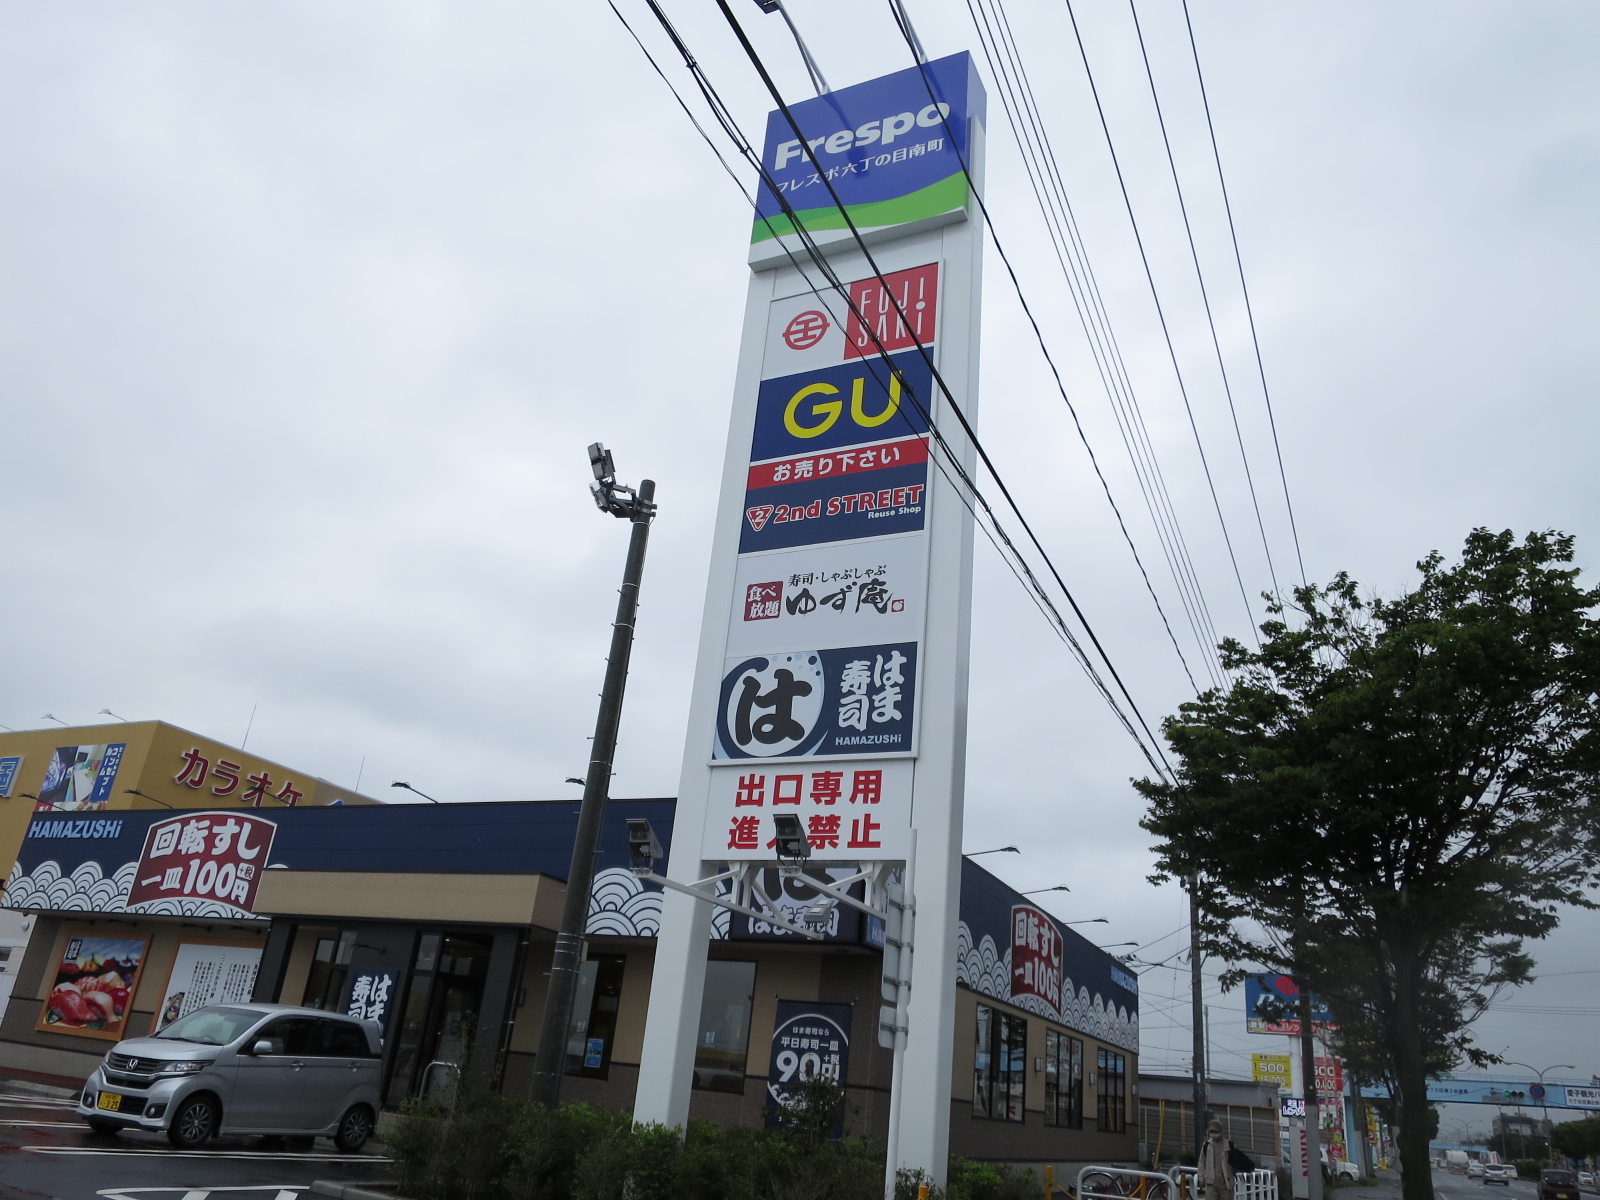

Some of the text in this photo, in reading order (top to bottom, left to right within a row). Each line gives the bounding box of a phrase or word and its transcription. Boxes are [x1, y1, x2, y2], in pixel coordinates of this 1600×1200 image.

[774, 102, 951, 171] Frespo
[776, 137, 945, 193] フレスポ六丁の目南町
[860, 277, 925, 316] FUJI
[783, 370, 902, 439] GU
[773, 447, 900, 482] お売り下さい
[773, 484, 924, 524] 2nd STREET
[867, 505, 922, 519] Reuse Shop
[748, 585, 777, 602] 食べ
[788, 565, 887, 587] 寿司・しゃぶしゃぶ
[749, 600, 781, 619] 放題
[786, 578, 894, 617] ゆず庵
[99, 748, 112, 776] ルーム
[99, 747, 119, 796] コンセプト
[173, 747, 303, 808] カラオケ
[735, 770, 883, 807] 出口専用
[150, 818, 261, 860] 回転すし
[1015, 912, 1060, 968] 回転すし
[781, 1036, 839, 1052] 平日寿司一皿
[792, 1026, 830, 1036] はま寿司なら
[1259, 1063, 1285, 1073] 500
